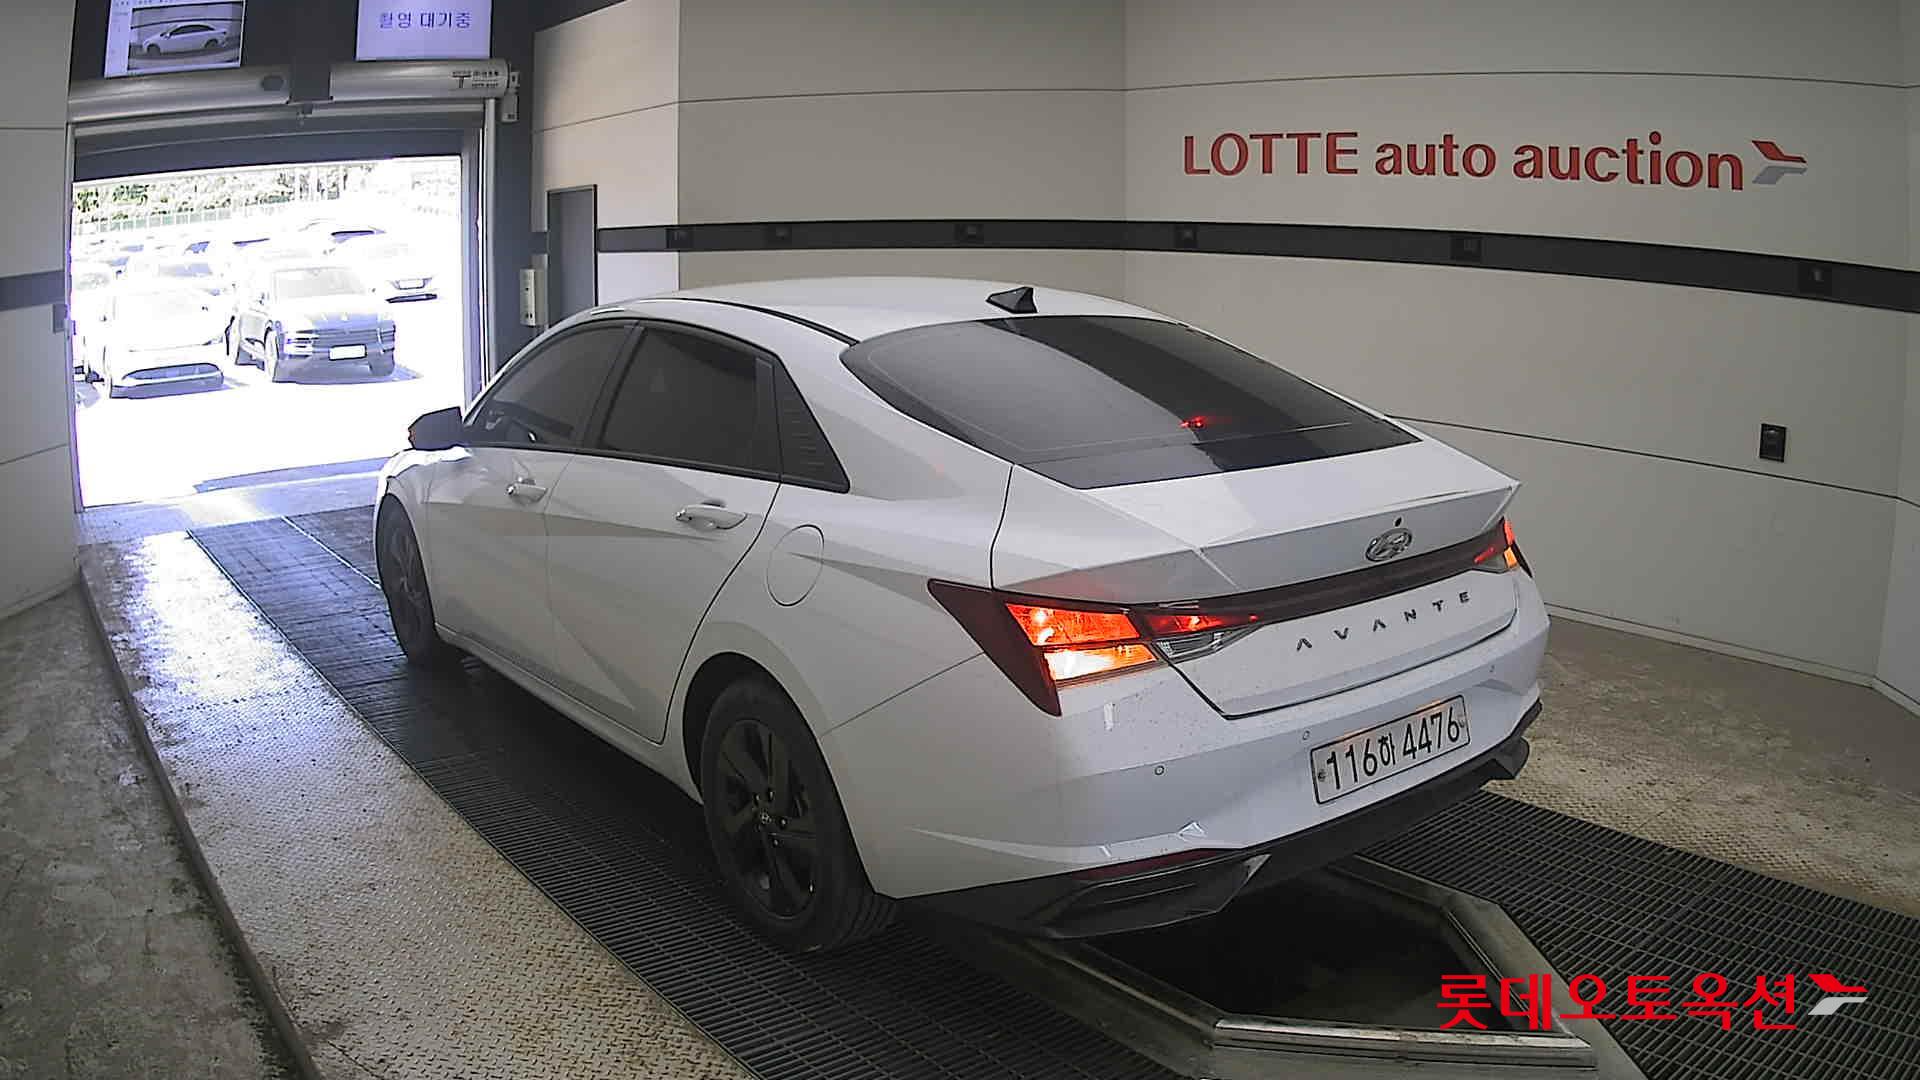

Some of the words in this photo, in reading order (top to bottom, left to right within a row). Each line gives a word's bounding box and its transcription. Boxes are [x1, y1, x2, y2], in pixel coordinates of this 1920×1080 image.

[419, 11, 472, 29] 대기중
[1184, 132, 1358, 176] LOTTE
[1375, 134, 1496, 178] auto
[1513, 131, 1744, 191] auction
[1296, 591, 1470, 651] AVANTE
